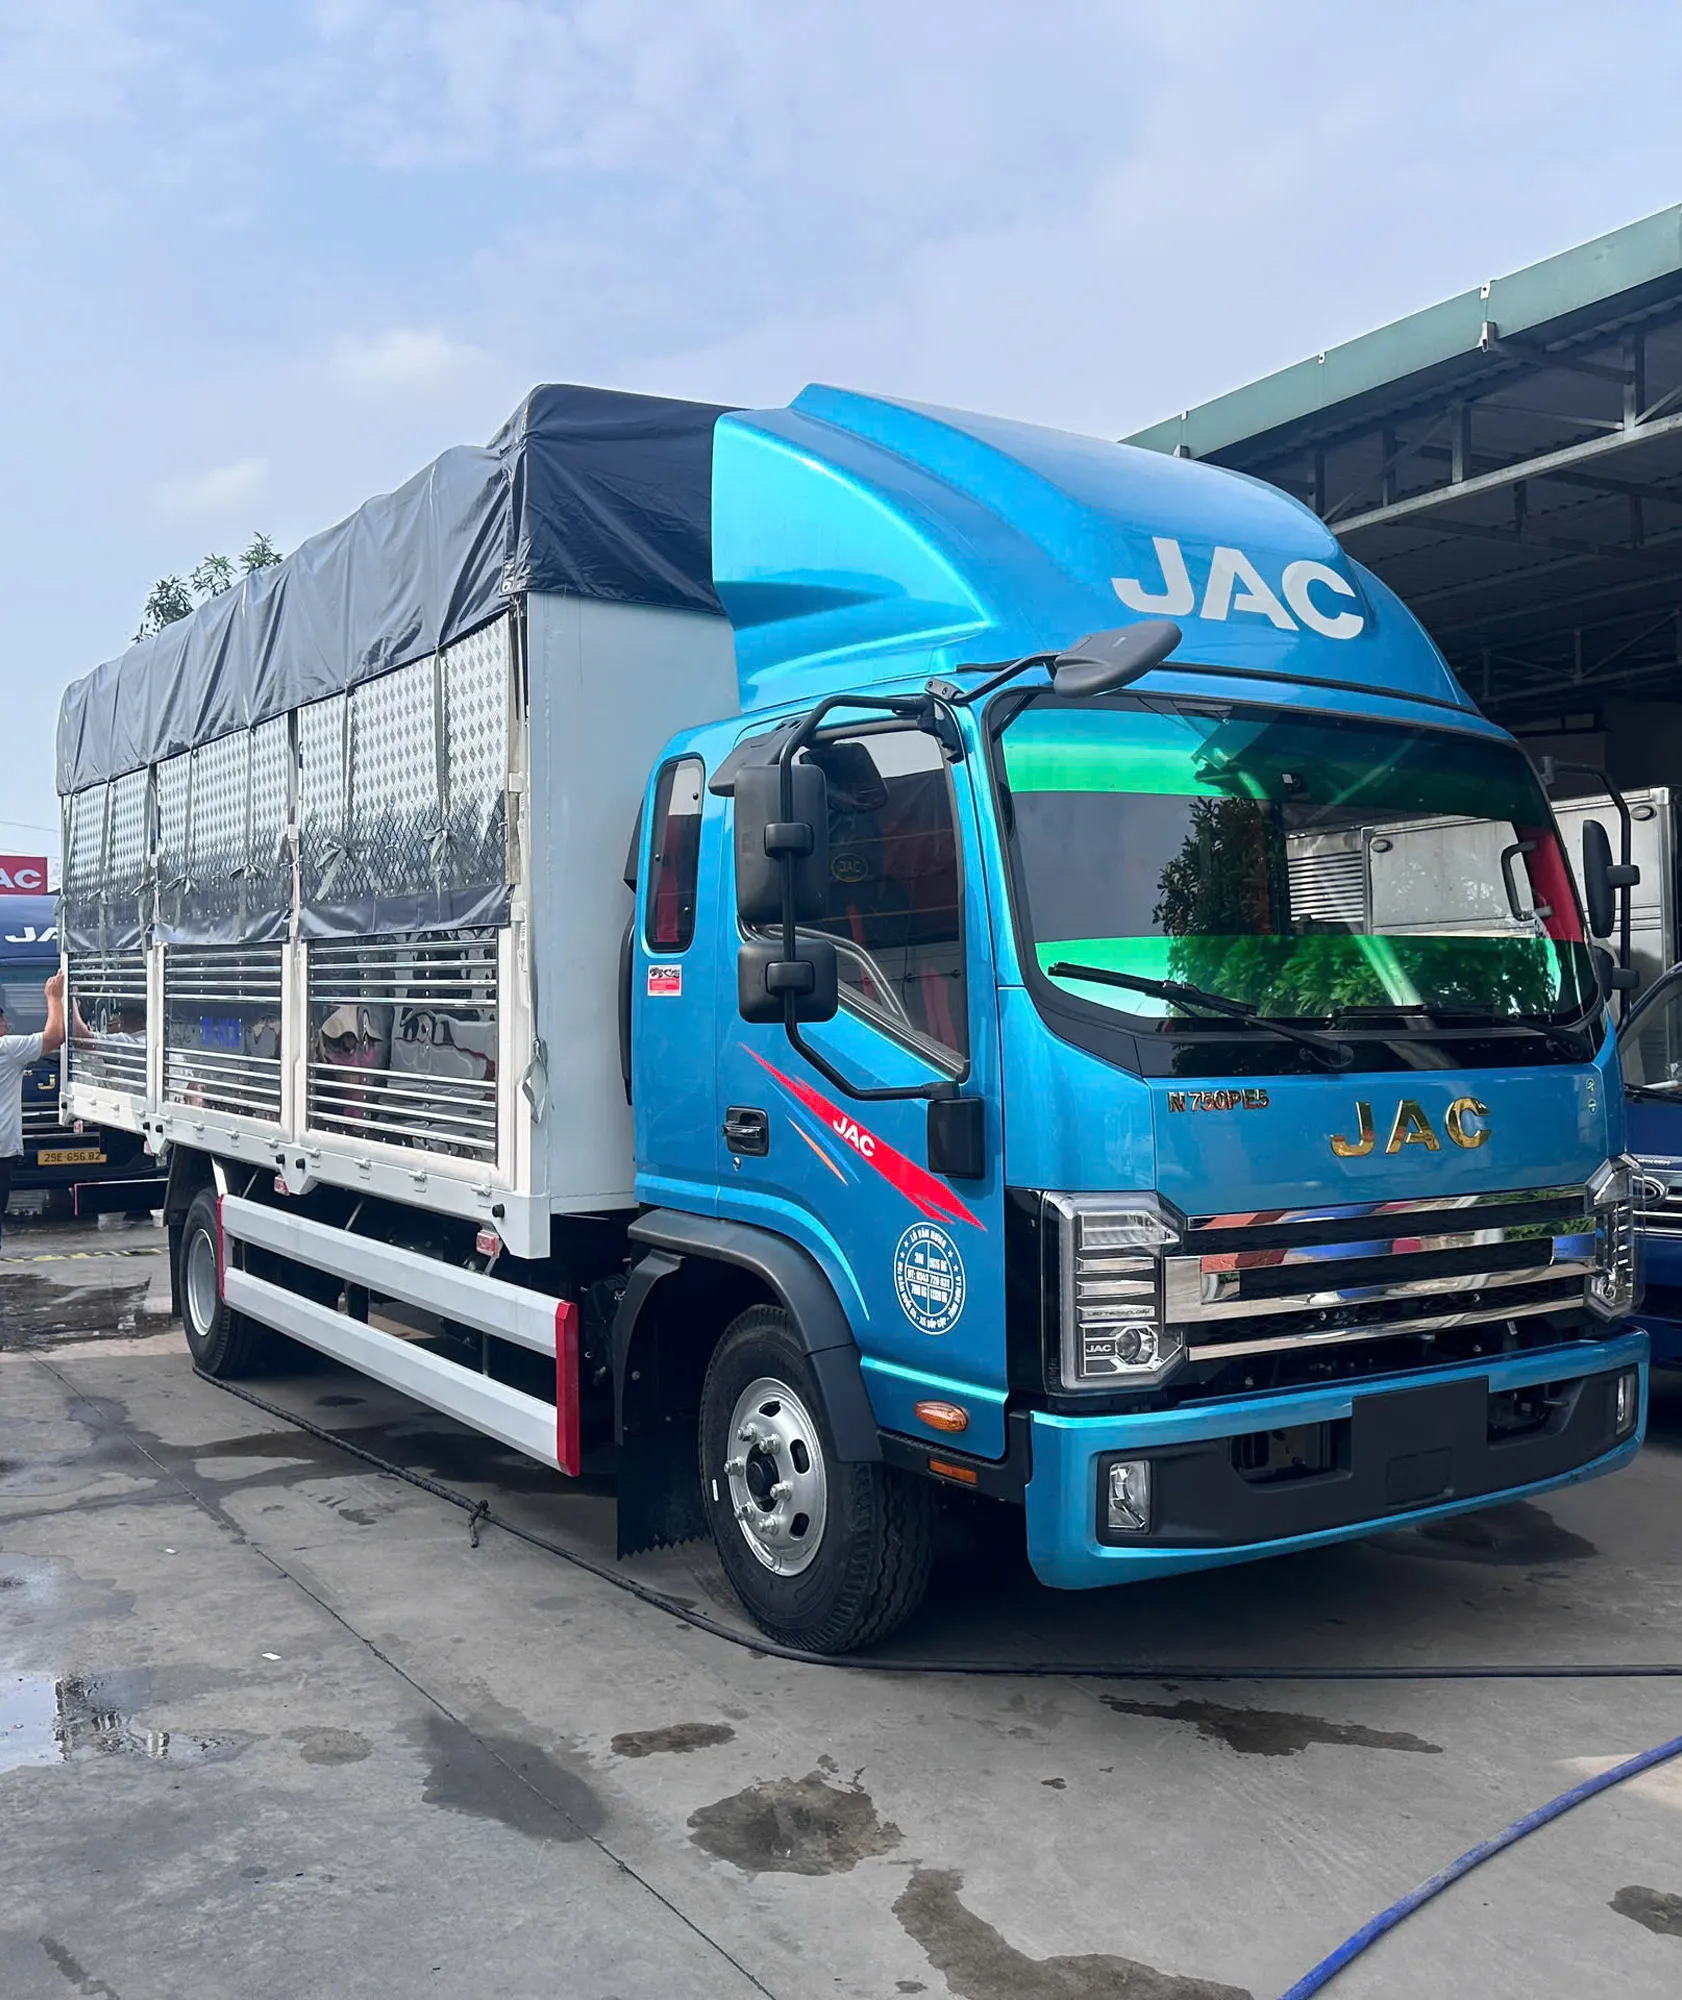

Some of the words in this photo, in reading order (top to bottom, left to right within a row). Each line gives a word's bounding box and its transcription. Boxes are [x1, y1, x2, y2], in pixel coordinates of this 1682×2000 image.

[1111, 537, 1364, 639] JAC
[833, 1116, 875, 1157] JAC
[1330, 1097, 1491, 1157] JAC
[1086, 1344, 1111, 1353] JAC
